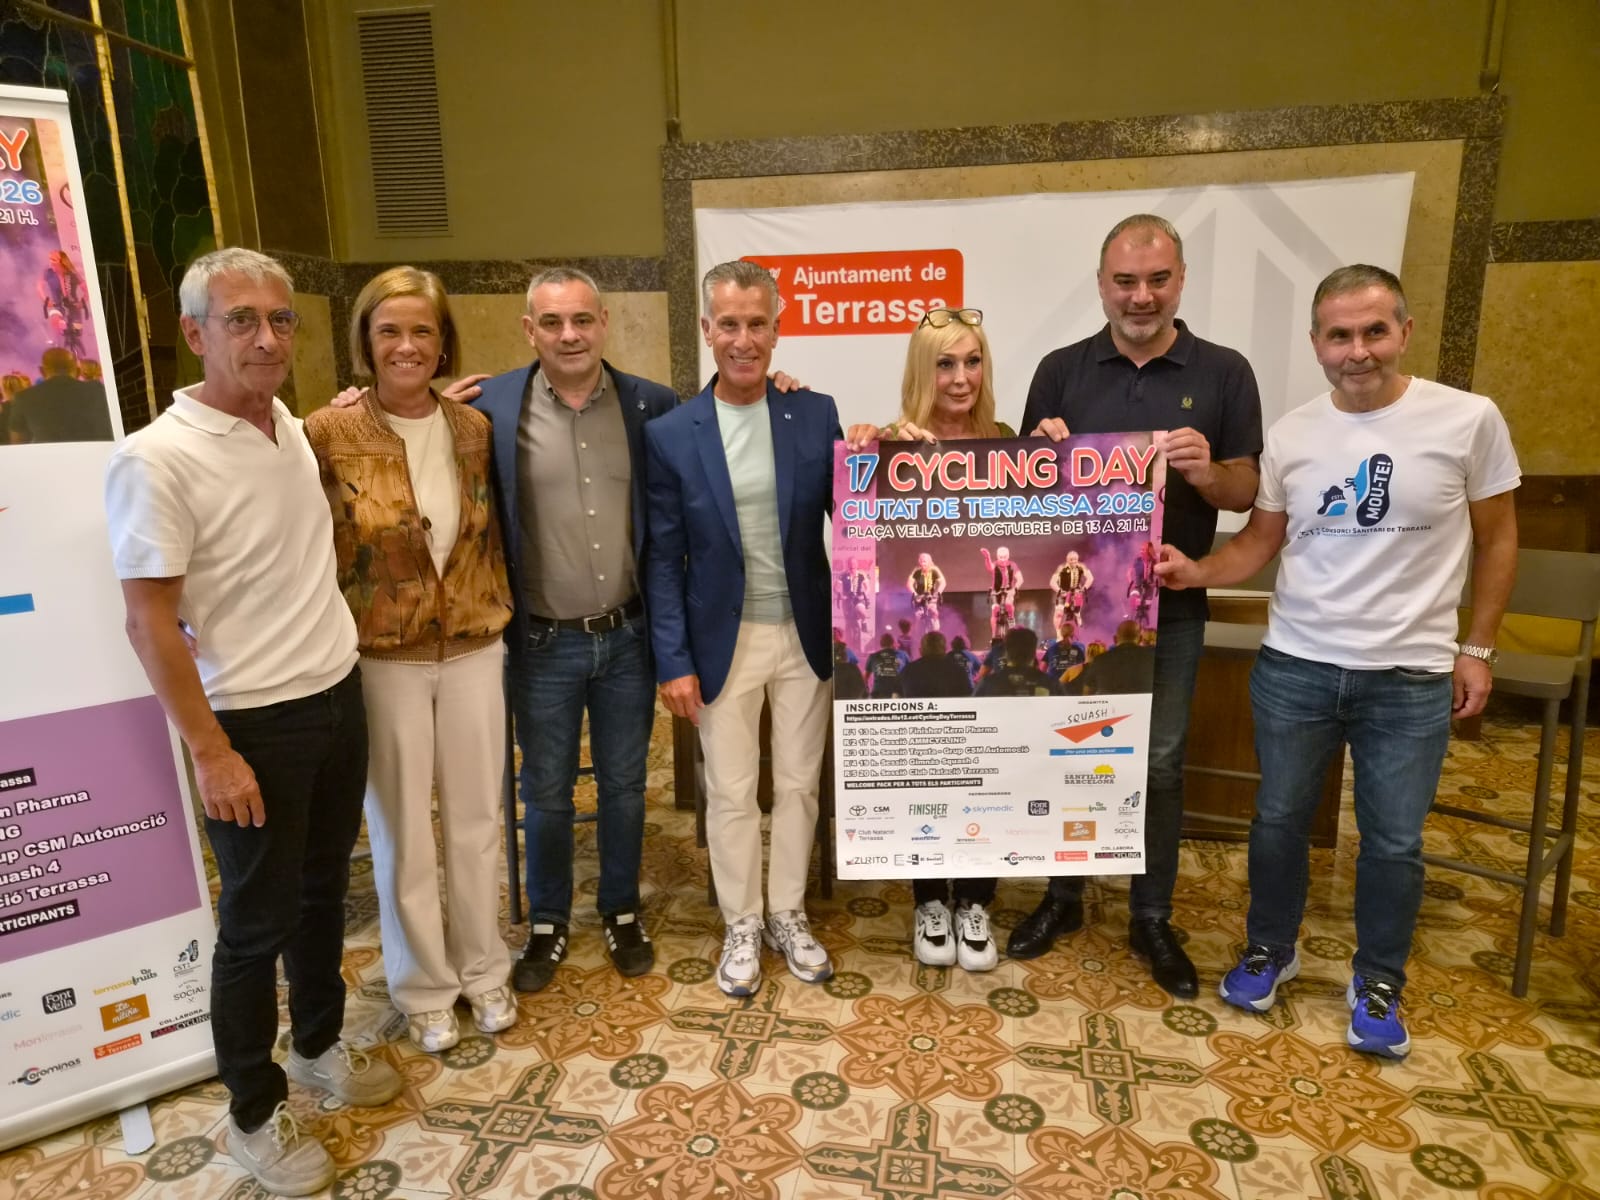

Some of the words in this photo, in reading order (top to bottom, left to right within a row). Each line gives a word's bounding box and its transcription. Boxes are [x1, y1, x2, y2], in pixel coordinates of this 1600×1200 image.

[17, 209, 39, 225] H.
[793, 266, 912, 288] Ajuntament
[920, 262, 947, 281] de
[846, 453, 879, 493] 17
[888, 448, 1057, 492] CYCLING
[1071, 445, 1157, 488] DAY
[1365, 461, 1392, 520] MOU-TE!
[842, 499, 922, 521] CIUTAT
[927, 498, 960, 520] DE
[965, 495, 1094, 519] TERRASSA
[1097, 492, 1155, 514] 2026
[847, 524, 894, 541] PLAÇA
[897, 523, 941, 538] VELLA
[952, 523, 966, 538] 17
[968, 521, 1052, 537] D'OCTUBRE
[1062, 520, 1083, 535] DE
[1085, 520, 1100, 534] 13
[1101, 520, 1113, 533] A
[1116, 519, 1132, 533] 21
[1133, 518, 1149, 532] H.
[846, 702, 924, 712] INSCRIPCIONS
[928, 702, 938, 711] A:
[1067, 708, 1108, 724] SQUASH
[15, 791, 90, 816] Pharma
[909, 803, 948, 815] FINISHER
[973, 805, 1014, 813] skymedic
[24, 837, 67, 857] CSM
[72, 812, 168, 847] Automoció
[0, 865, 44, 886] uash
[47, 860, 61, 874] 4
[27, 872, 111, 900] Terrassa
[45, 990, 72, 1003] Font
[173, 985, 207, 1001] SOCIAL
[47, 999, 75, 1013] Vella
